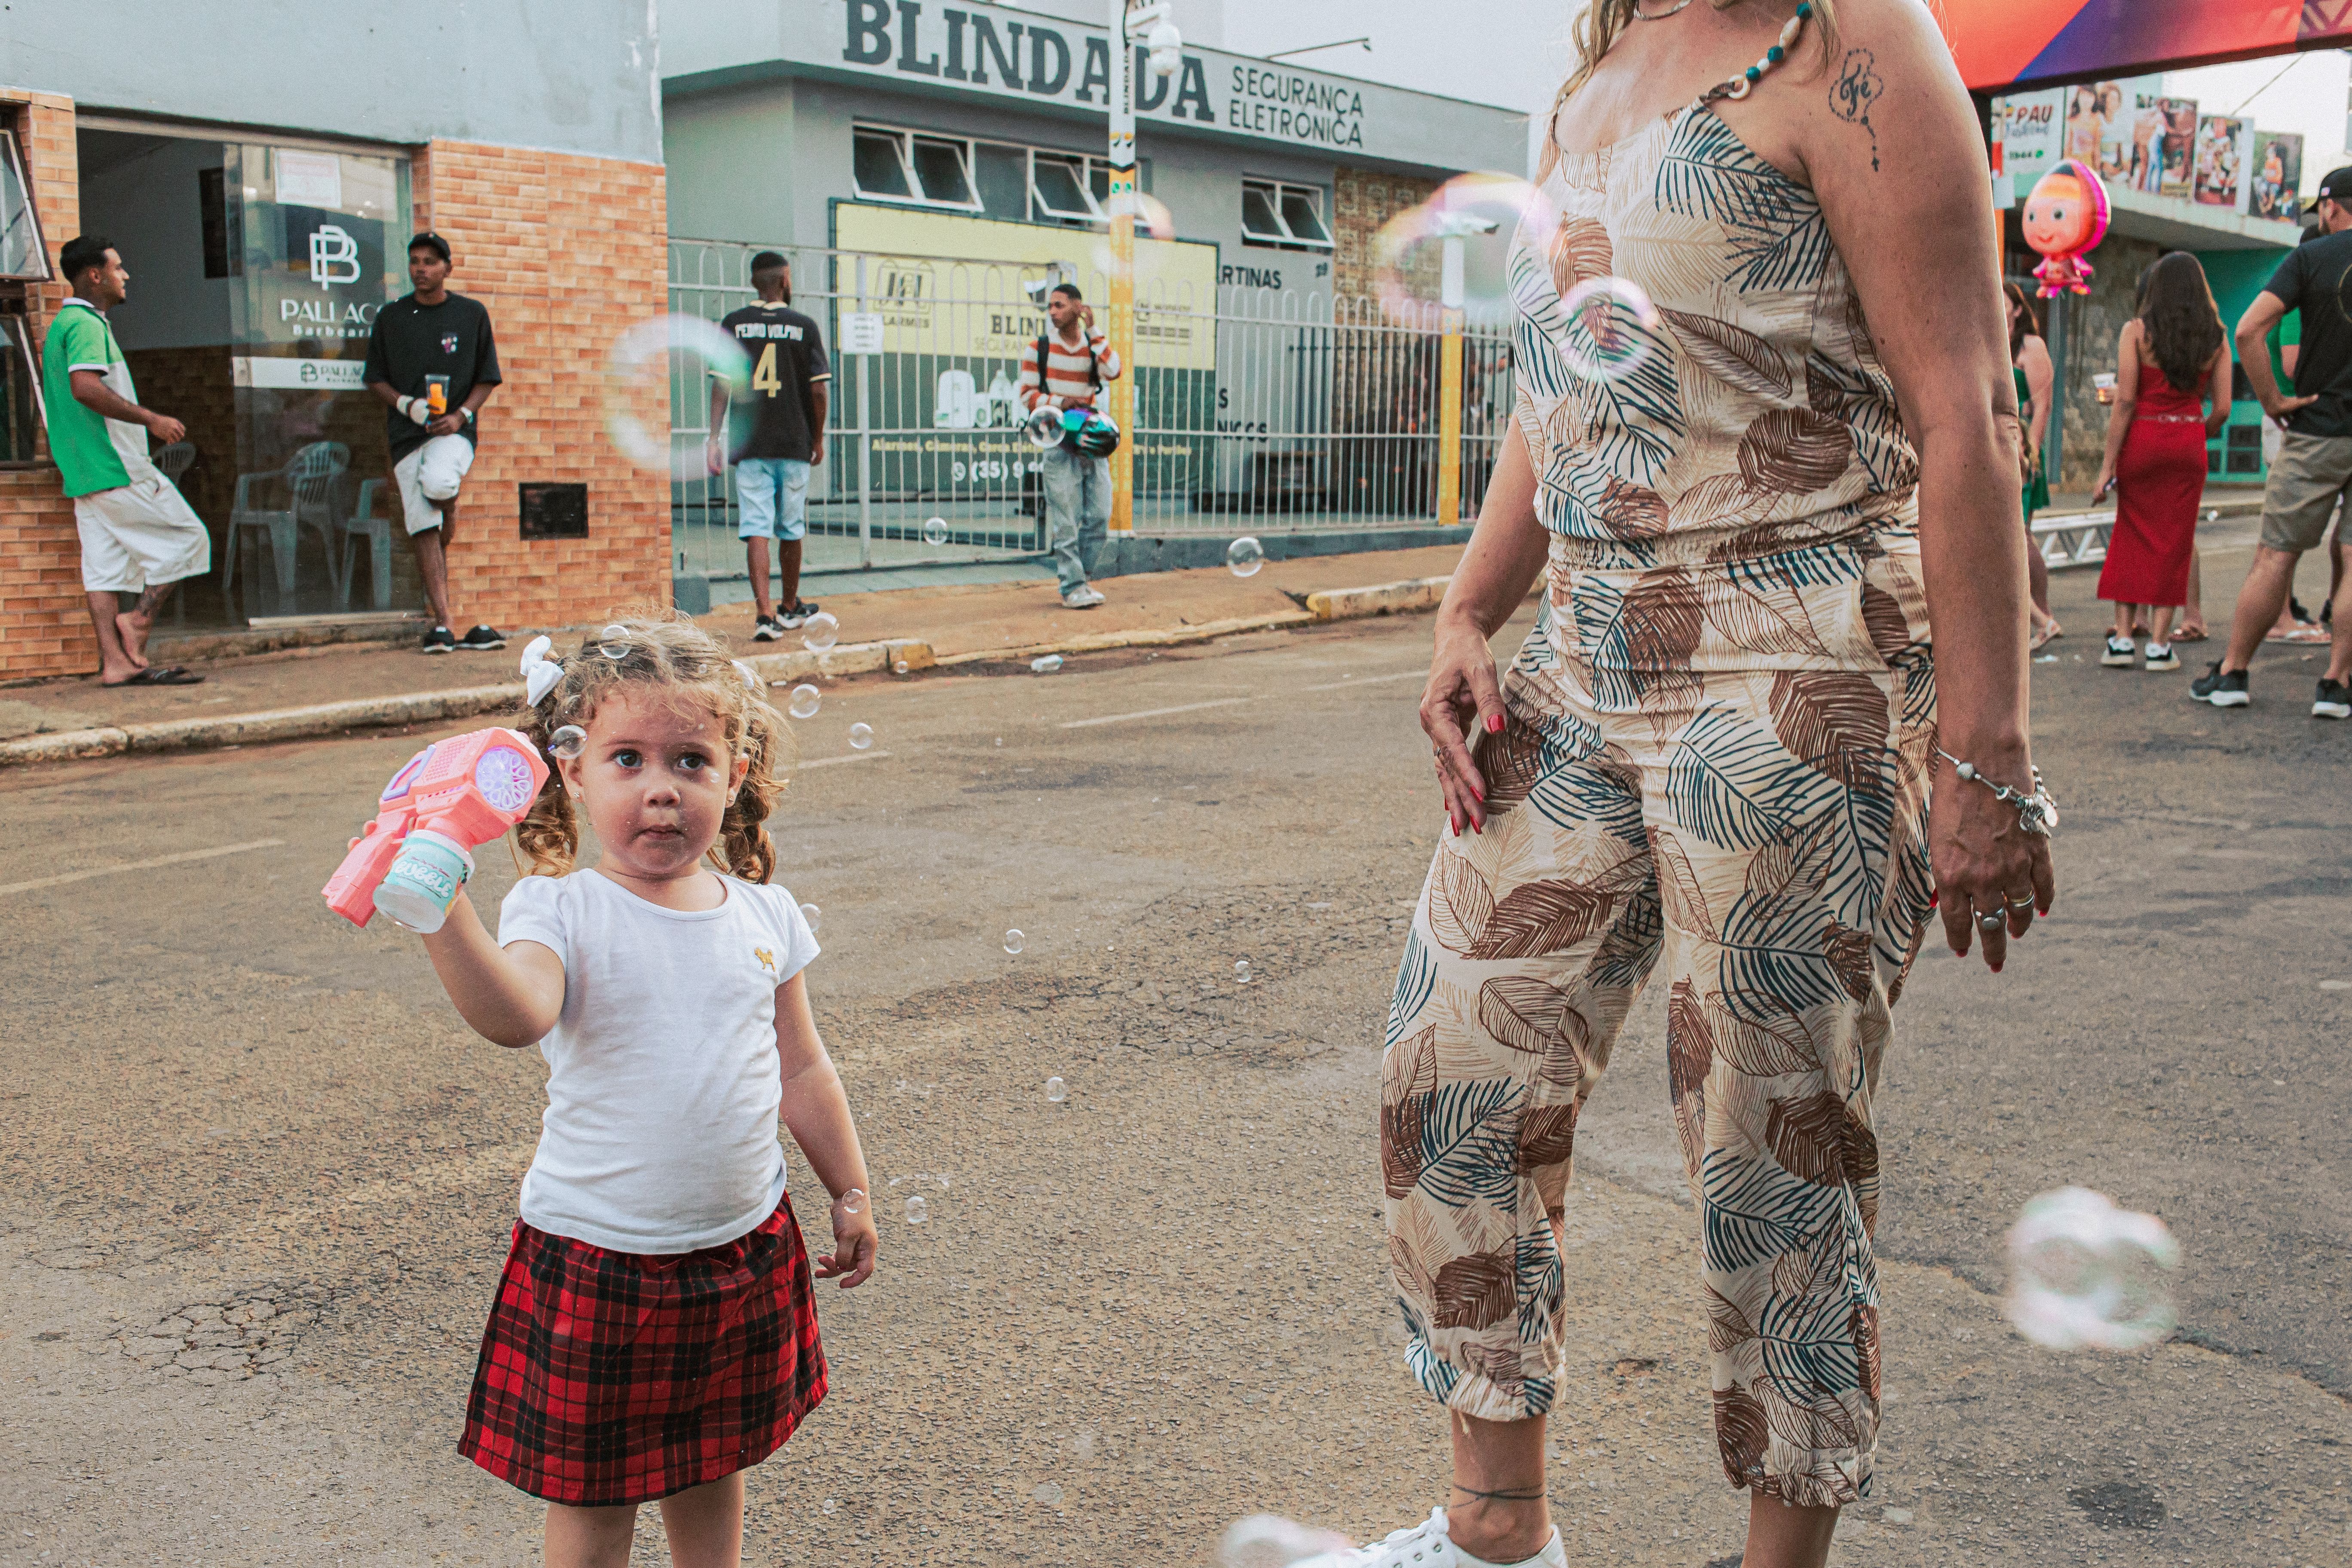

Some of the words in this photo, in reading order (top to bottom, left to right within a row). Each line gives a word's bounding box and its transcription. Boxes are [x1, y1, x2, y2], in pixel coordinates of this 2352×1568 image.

[842, 0, 1215, 122] BLINDADA
[1217, 265, 1281, 290] RTINAS
[281, 299, 382, 325] PALLAC
[293, 325, 373, 337] Barbeari
[753, 343, 782, 398] 4
